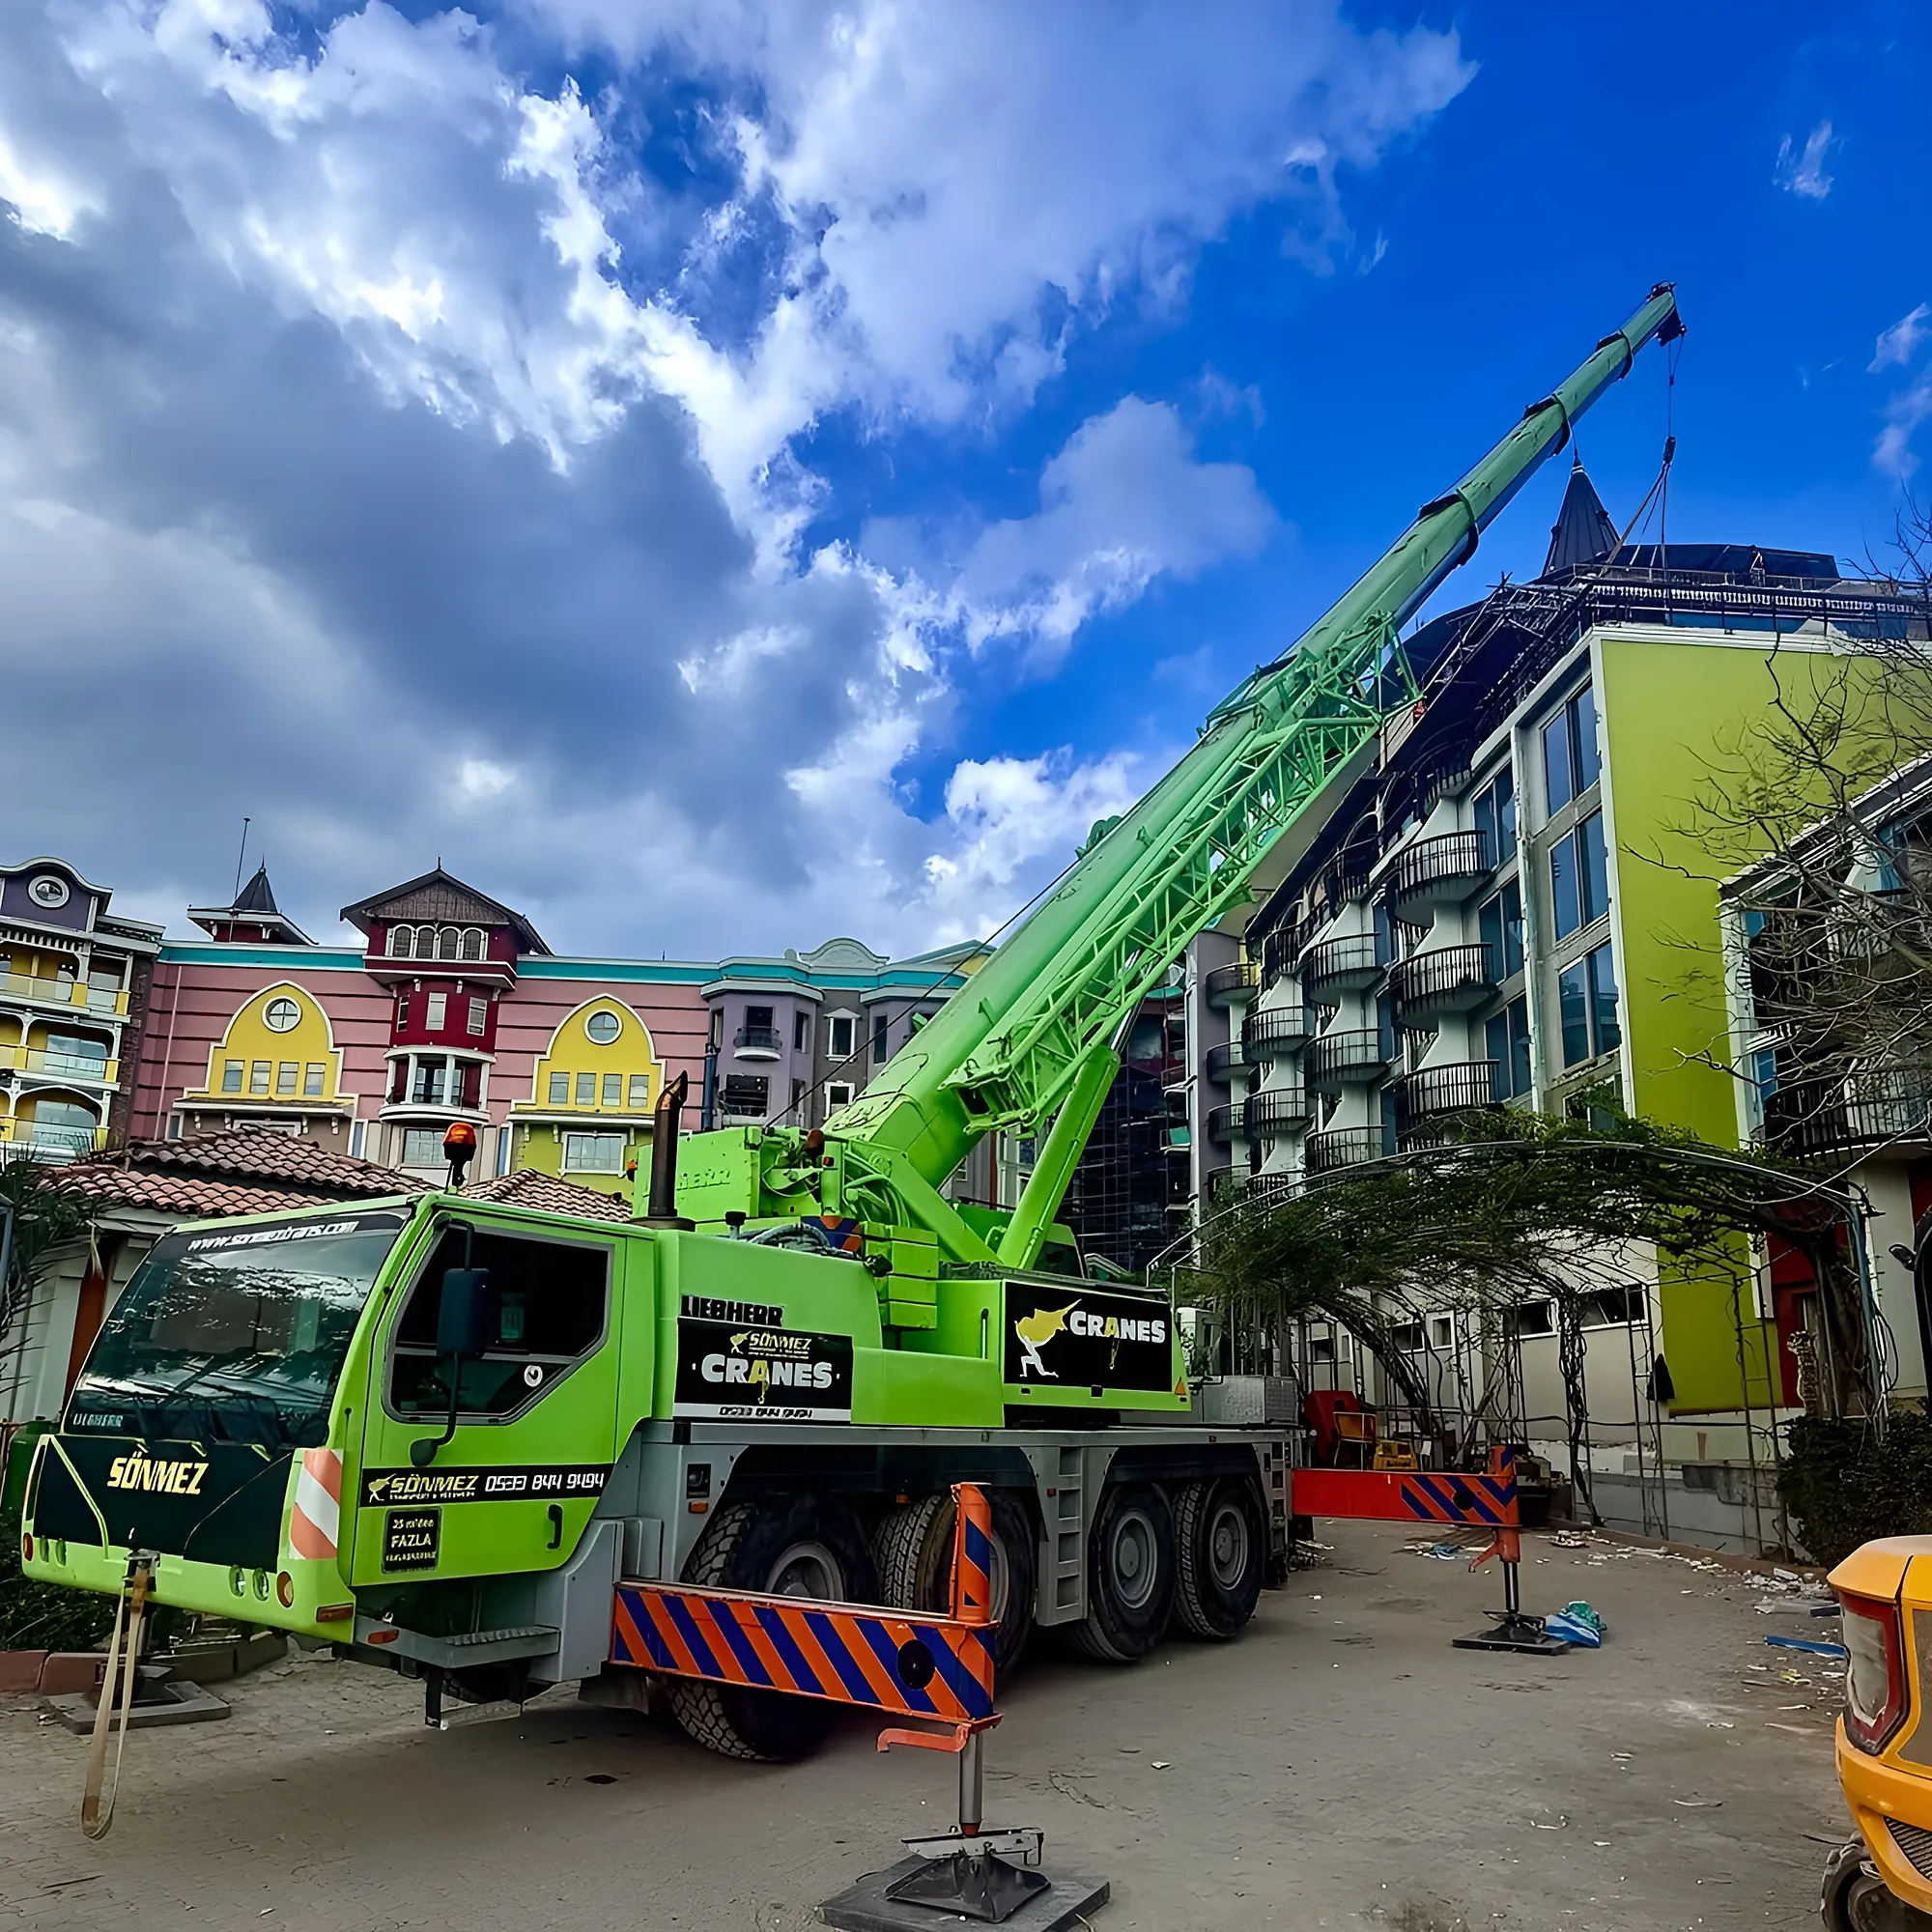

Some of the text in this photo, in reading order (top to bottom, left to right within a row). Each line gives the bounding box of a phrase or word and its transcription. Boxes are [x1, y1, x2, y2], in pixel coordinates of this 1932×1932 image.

[680, 1295, 784, 1327] LIEBHERR
[1069, 1311, 1166, 1344] CRANES
[701, 1353, 833, 1388] CRANES
[107, 1451, 209, 1494] SÖNMEZ
[389, 1473, 479, 1493] SÖNMEZ
[531, 1474, 562, 1490] 844
[566, 1473, 605, 1490] 9494
[390, 1533, 431, 1548] FAZLA
